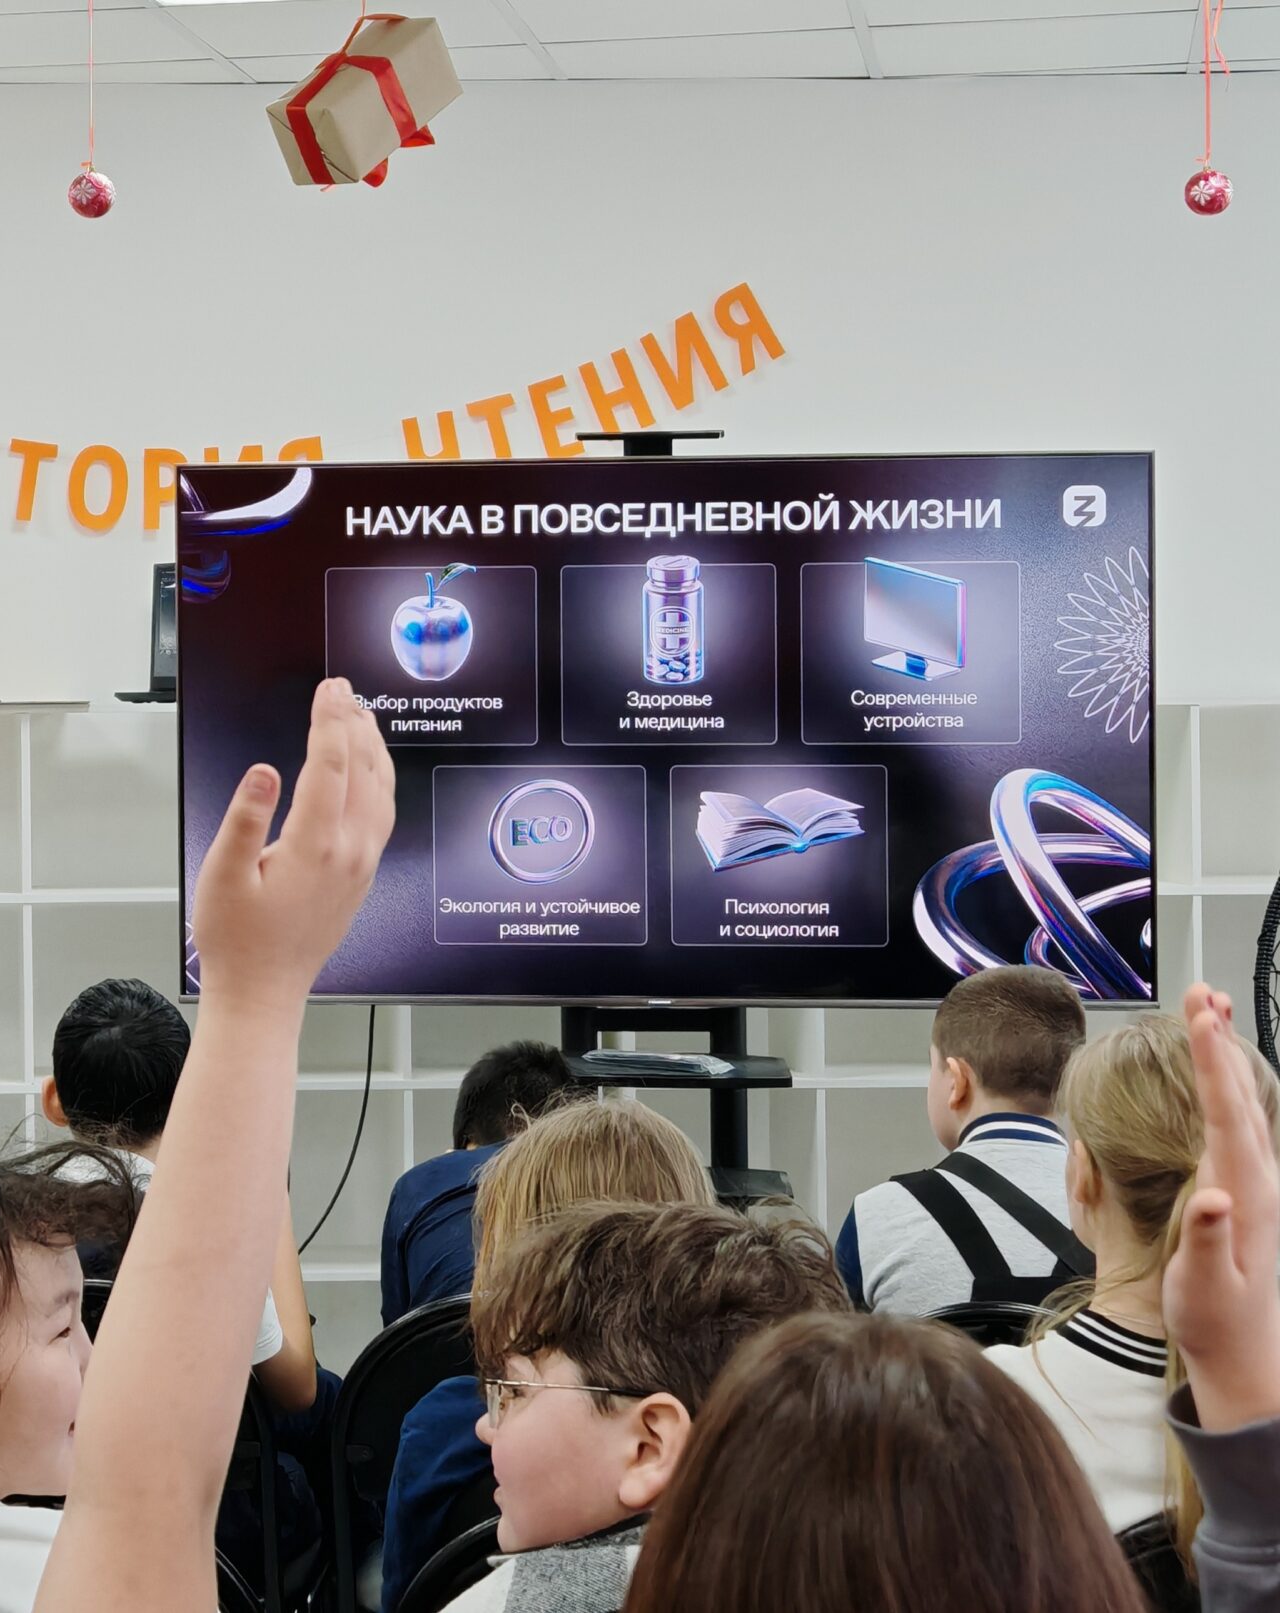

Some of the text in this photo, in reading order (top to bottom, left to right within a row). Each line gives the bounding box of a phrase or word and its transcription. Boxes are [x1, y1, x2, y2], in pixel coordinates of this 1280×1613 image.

[345, 493, 1003, 538] НАУКА В ПОВСЕДНЕВНОЙ ЖИЗНИ
[413, 696, 503, 712] продуктов
[626, 690, 713, 710] Здоровье
[850, 689, 978, 709] Современные
[391, 719, 462, 732] питания
[619, 716, 725, 731] и медицина
[863, 712, 964, 732] устройства
[510, 816, 573, 847] ECO
[439, 897, 642, 917] Экология и устойчивое
[725, 898, 830, 915] Психология
[499, 923, 580, 939] развитие
[719, 924, 840, 939] и социология
